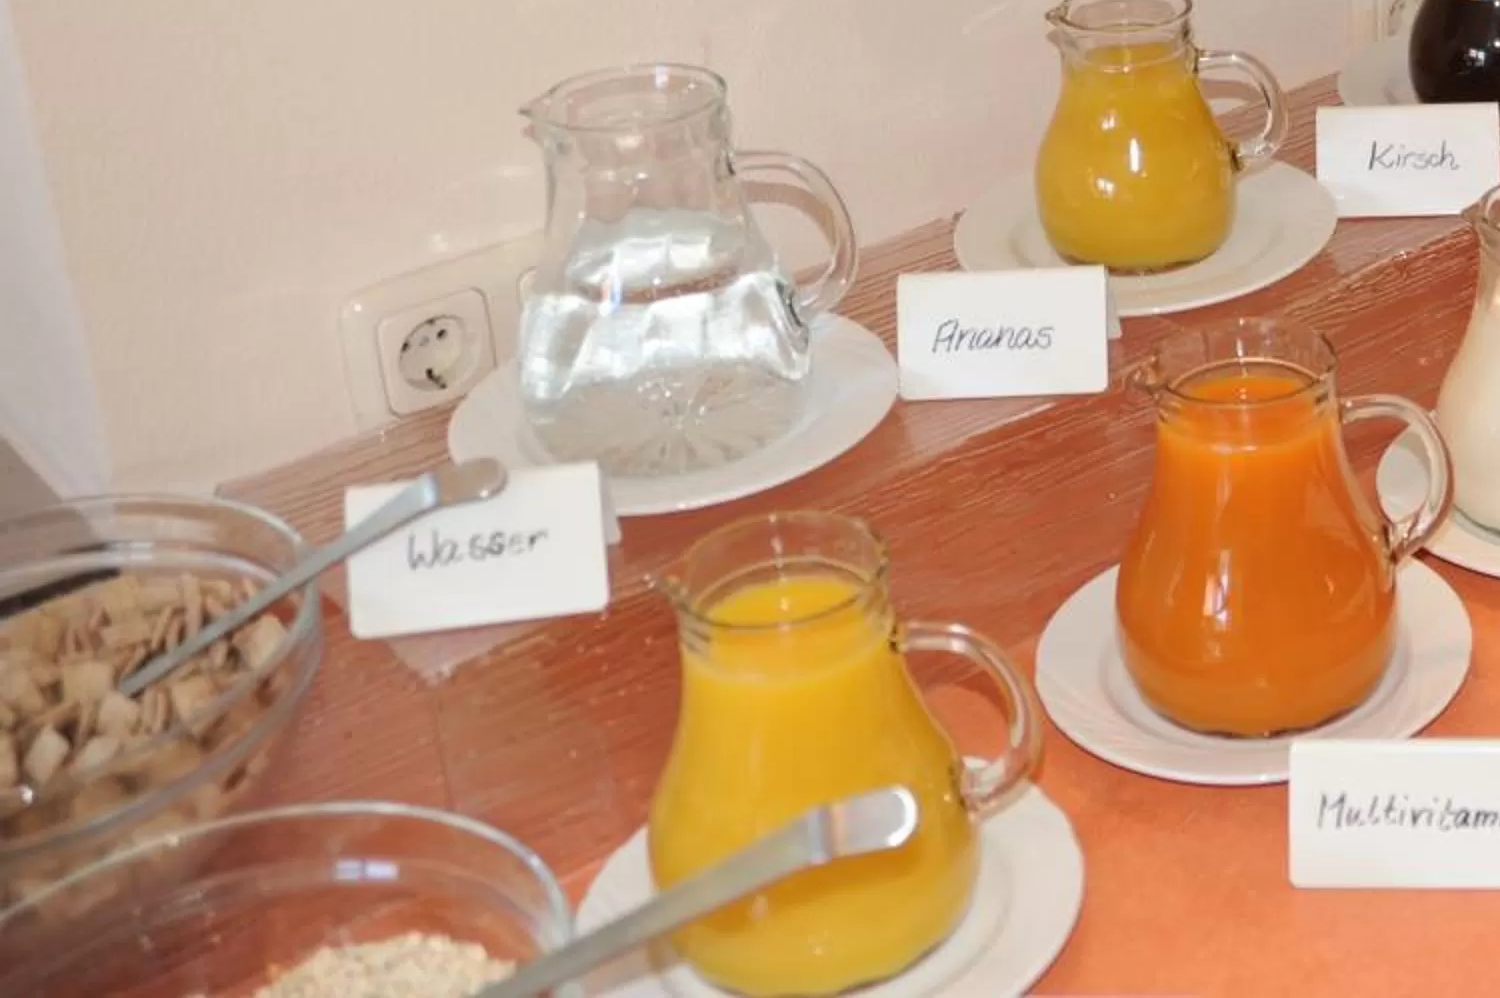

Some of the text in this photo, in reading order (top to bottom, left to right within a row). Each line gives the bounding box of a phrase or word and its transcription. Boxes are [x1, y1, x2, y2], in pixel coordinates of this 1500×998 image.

[1368, 139, 1460, 170] Kirsch
[931, 317, 1055, 354] Ananas
[406, 526, 549, 572] Wasser
